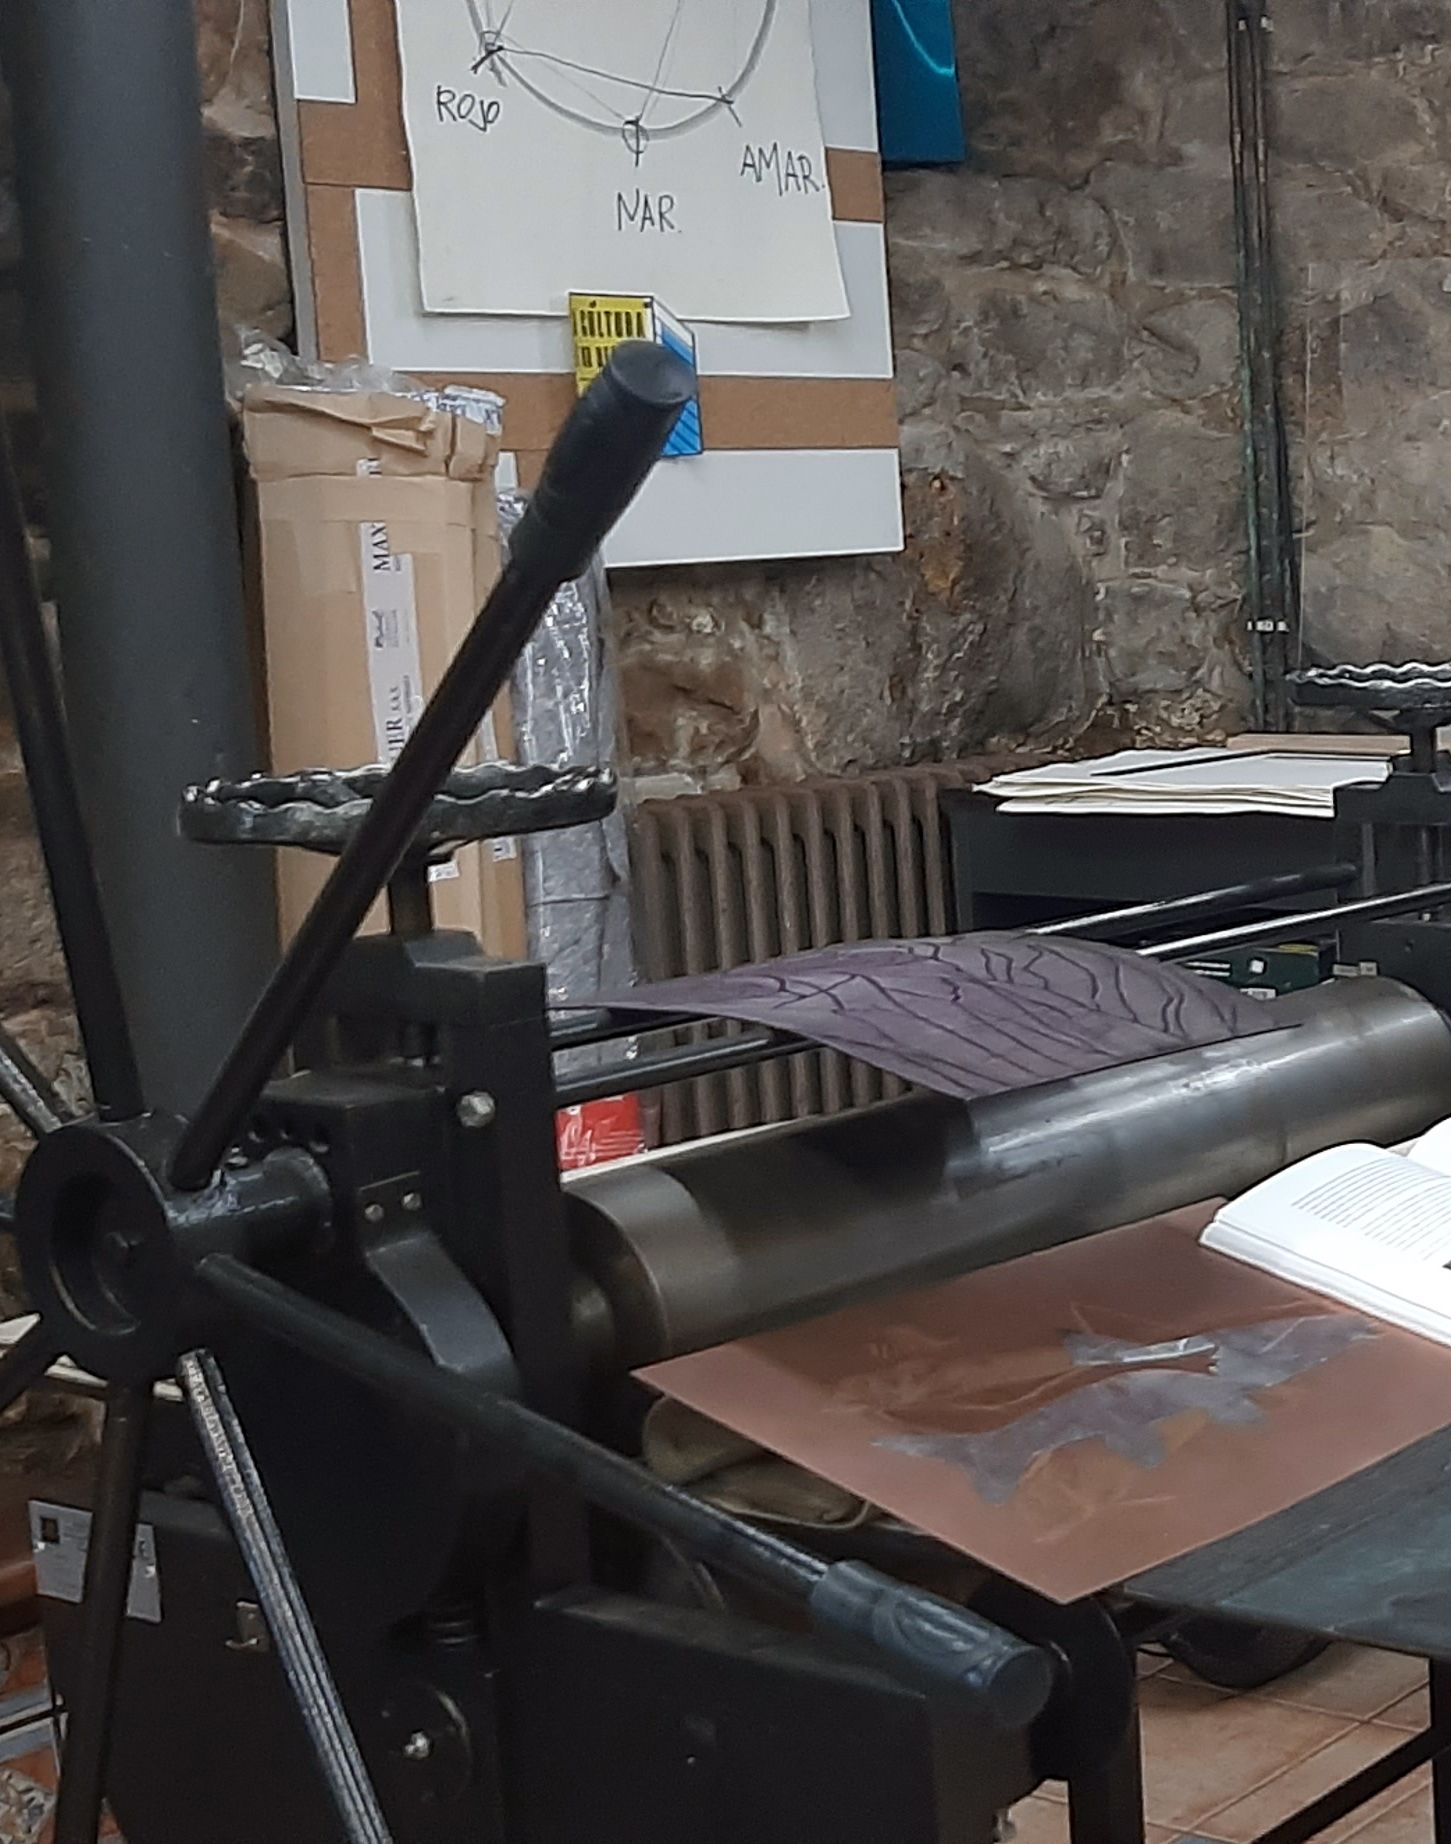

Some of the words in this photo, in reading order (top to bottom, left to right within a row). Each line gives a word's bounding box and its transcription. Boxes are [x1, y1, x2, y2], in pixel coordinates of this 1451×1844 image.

[436, 84, 501, 132] ROJO
[740, 142, 826, 197] AMAR.
[617, 188, 682, 233] NAR.
